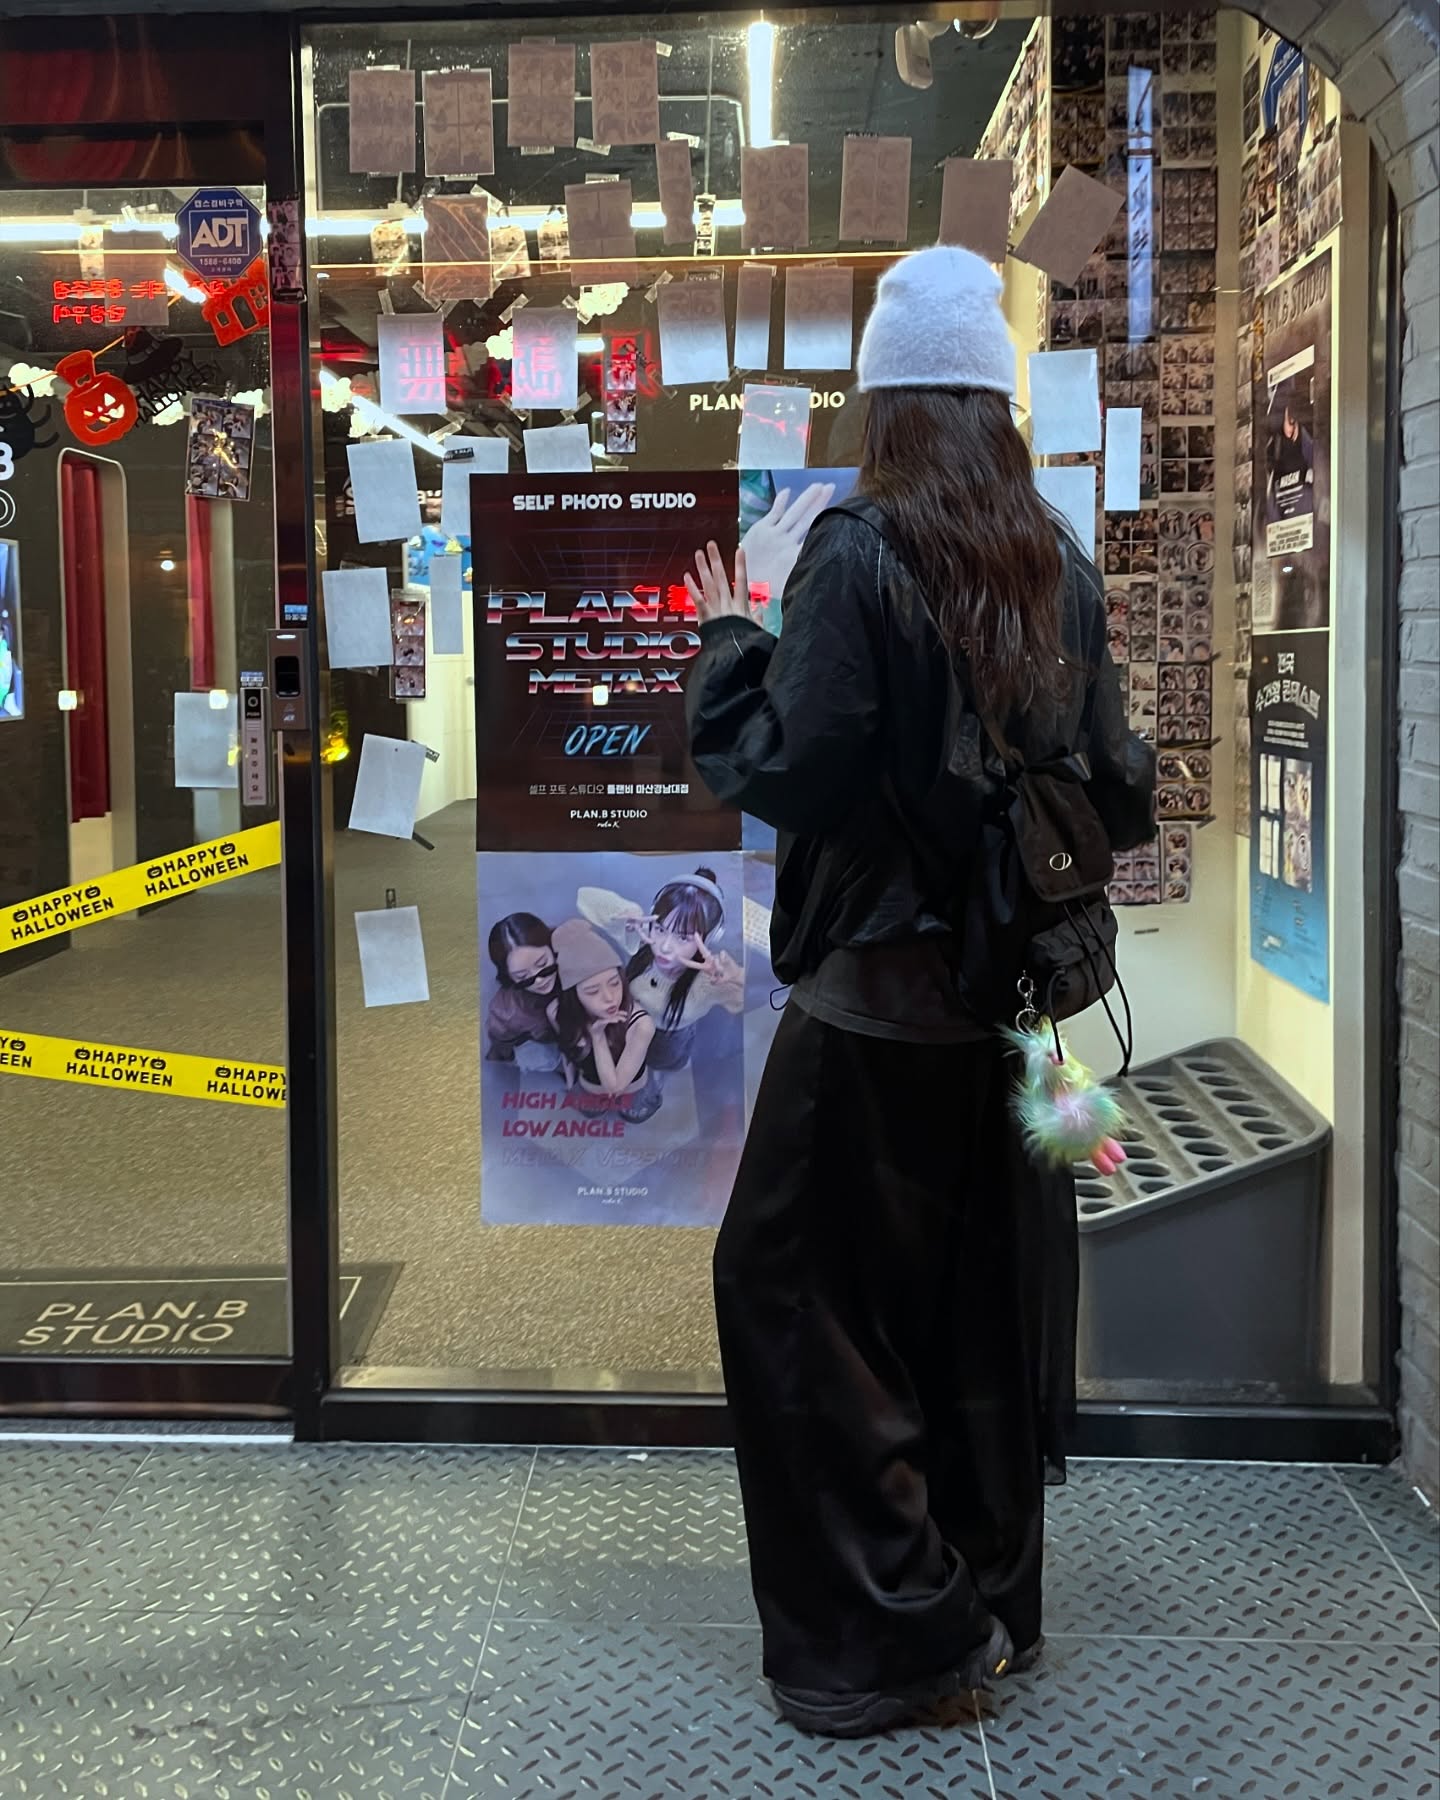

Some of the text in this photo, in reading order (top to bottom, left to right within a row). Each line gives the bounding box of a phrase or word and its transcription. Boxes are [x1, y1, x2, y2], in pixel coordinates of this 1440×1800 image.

[191, 217, 248, 249] ADT
[513, 492, 697, 511] SELF PHOTO STUDIO
[505, 631, 702, 661] STUDIO
[564, 724, 652, 756] OPEN
[529, 784, 689, 795] 셀프 포토 스튜디오 플랜비 마산경남대점
[570, 809, 648, 819] PLAN.B STUDIO
[163, 846, 220, 874] HAPPY
[144, 853, 250, 898] HALLOWEEN
[30, 889, 83, 918] HAPPY
[11, 897, 114, 941] HALLOWEEN
[92, 1049, 150, 1069] HAPPY
[66, 1062, 173, 1087] HALLOWEEN
[502, 1092, 557, 1110] HIGH
[502, 1119, 625, 1138] LOW ANGLE
[614, 1187, 649, 1196] STUDIO
[36, 1300, 249, 1323] PLAN.B
[17, 1323, 235, 1346] STUDIO
